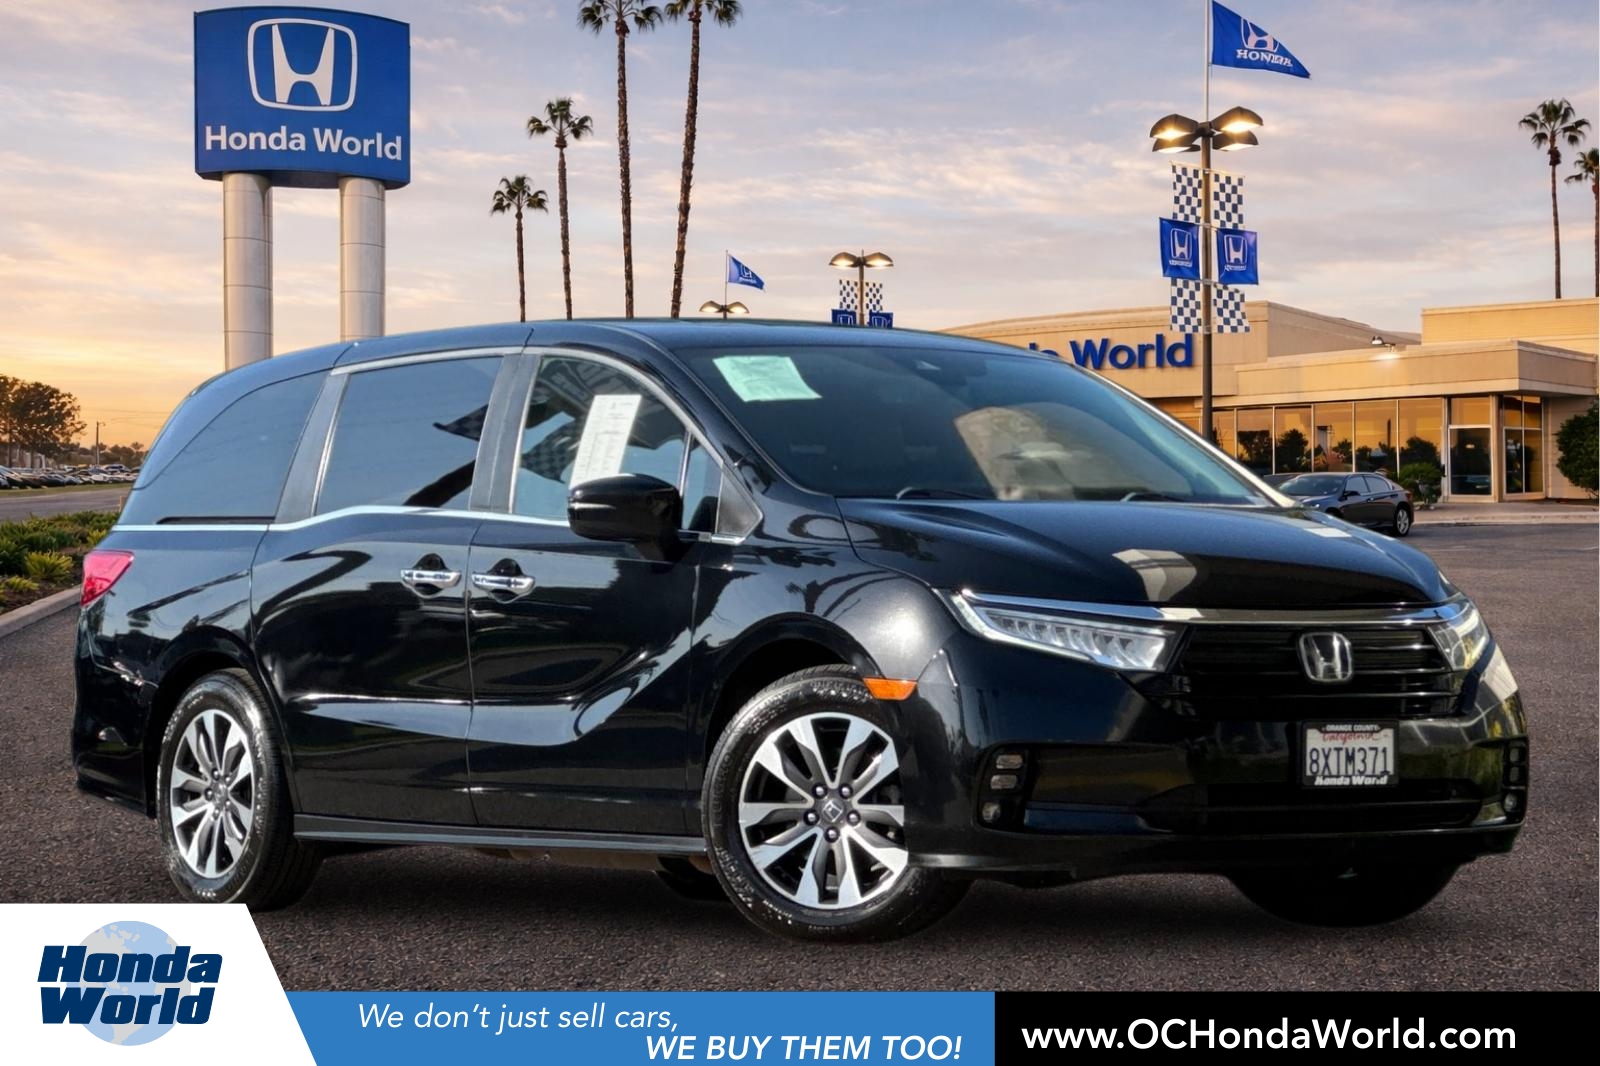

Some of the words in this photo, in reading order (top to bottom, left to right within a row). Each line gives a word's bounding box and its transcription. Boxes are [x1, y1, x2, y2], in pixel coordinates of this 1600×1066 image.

[205, 125, 306, 151] Honda
[313, 127, 402, 161] World
[1070, 333, 1193, 370] World
[1309, 746, 1390, 776] 8XTM371
